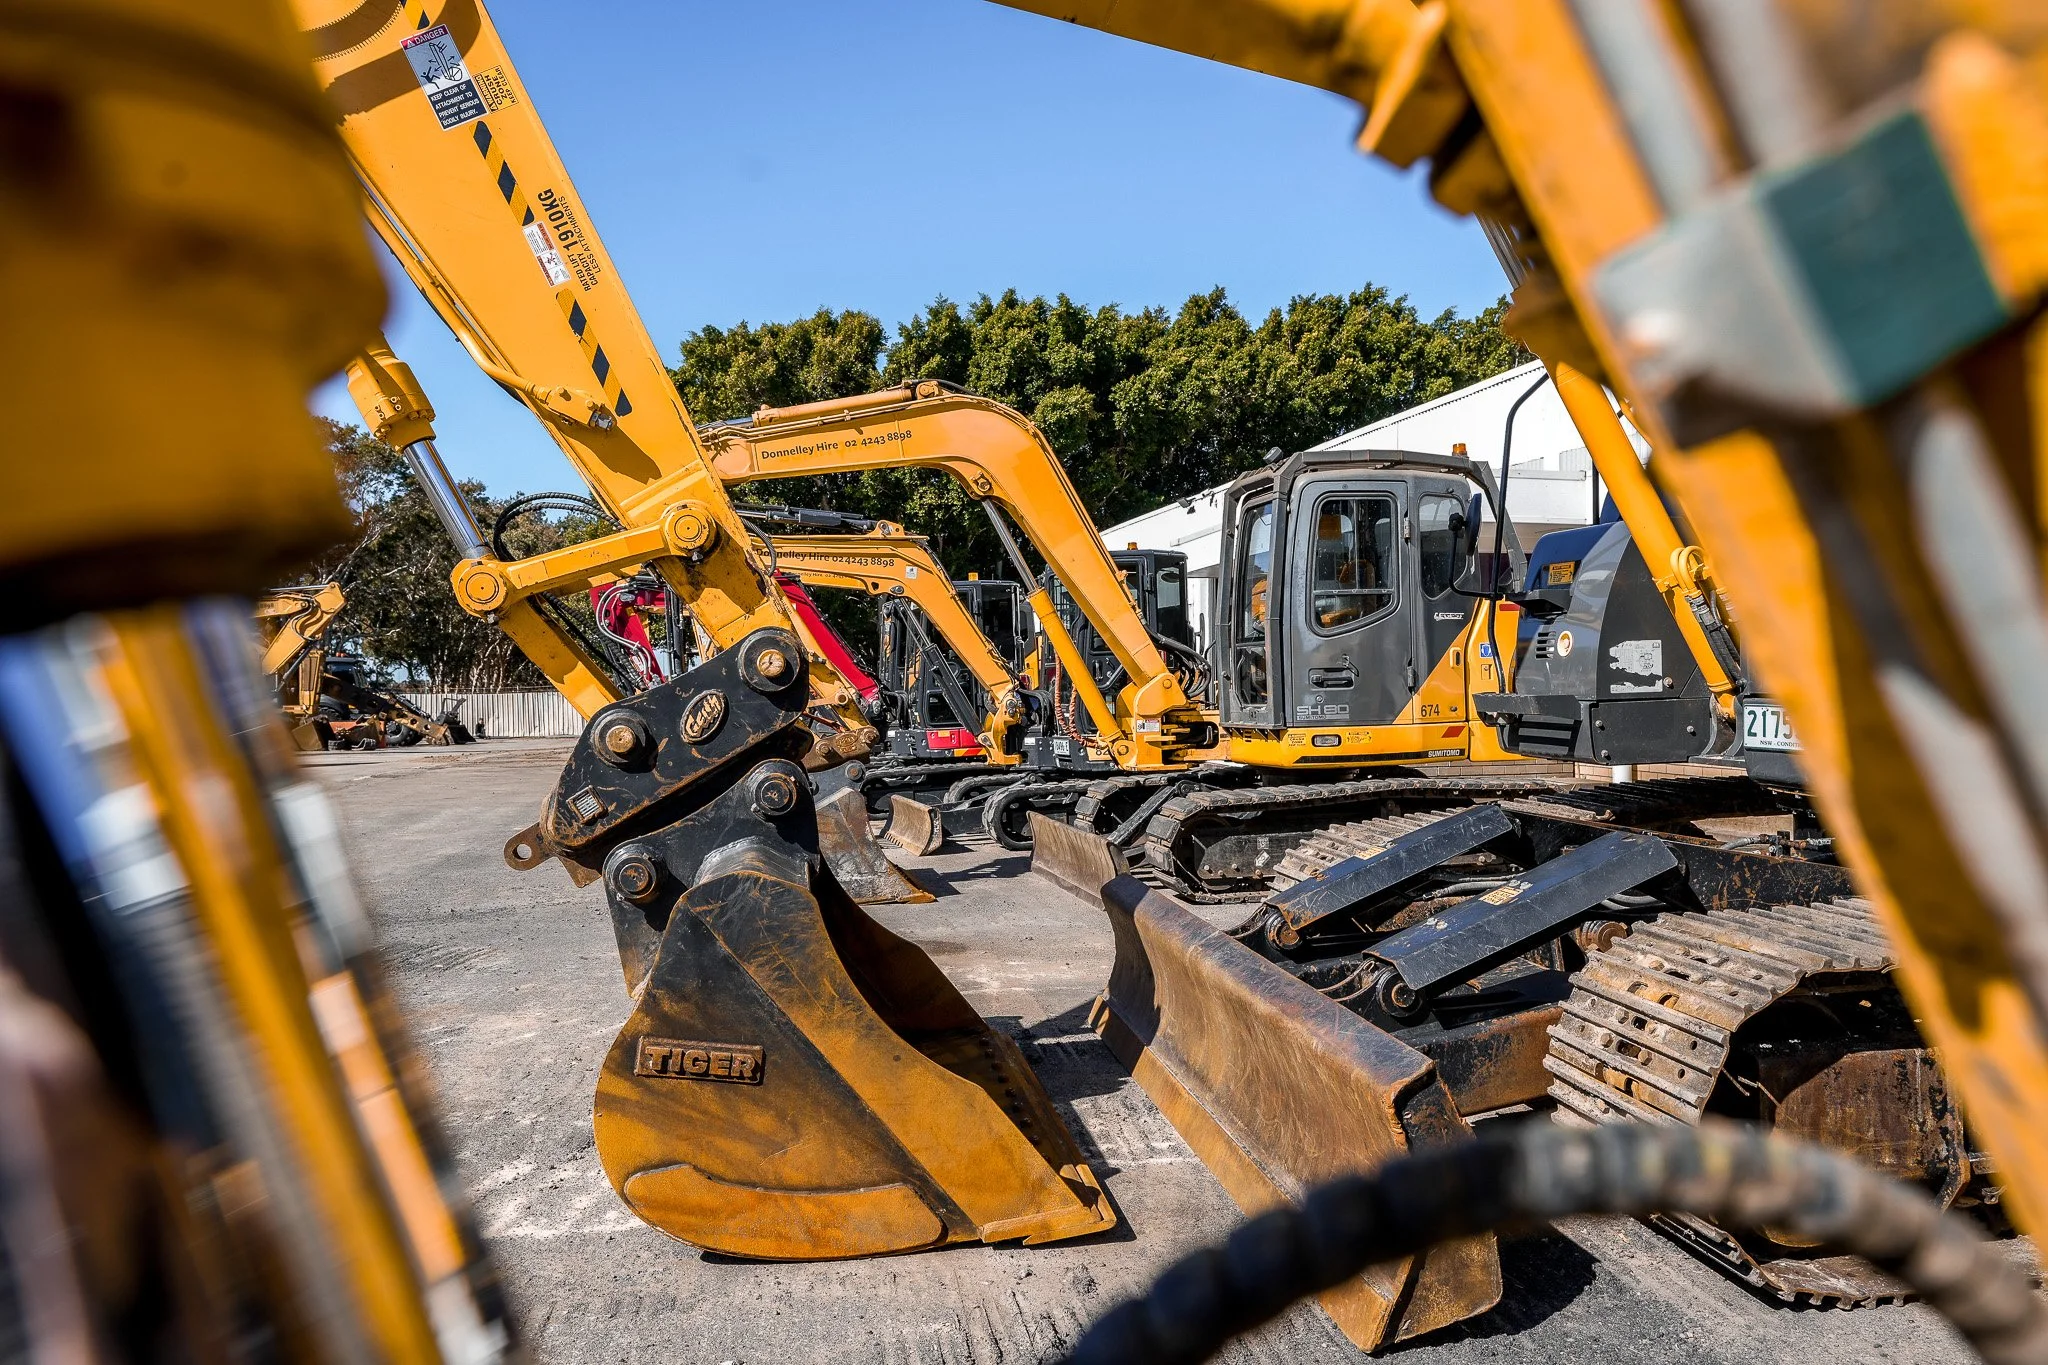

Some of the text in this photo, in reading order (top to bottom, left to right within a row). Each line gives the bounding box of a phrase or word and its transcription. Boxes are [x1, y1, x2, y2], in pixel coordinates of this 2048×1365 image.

[414, 28, 445, 44] DANGER
[431, 84, 466, 101] KEEP CLEAR OF
[484, 75, 503, 104] CRUSH
[492, 76, 508, 100] ZONE
[494, 68, 516, 103] KEEP CLEAR
[435, 92, 472, 110] ATTACHMENT TO
[438, 98, 480, 118] PREVENT SERIOUS
[442, 115, 459, 126] BODILY
[538, 188, 580, 252] 1910KG
[558, 196, 602, 274] LESS ATTACHMENTS
[568, 254, 592, 292] RATED LIFT
[577, 253, 598, 286] CAPACITY
[762, 445, 814, 460] Donnelley
[816, 442, 838, 452] Hire
[860, 436, 886, 446] 4243
[887, 430, 912, 442] 8898
[756, 548, 807, 562] Donelley
[808, 552, 830, 561] Hire
[870, 557, 895, 568] 8898
[1296, 704, 1350, 715] SH 80
[1420, 704, 1440, 717] 674
[1747, 710, 1793, 740] 2175
[1428, 750, 1460, 758] SUMITOMO
[645, 1046, 757, 1078] TIGER
